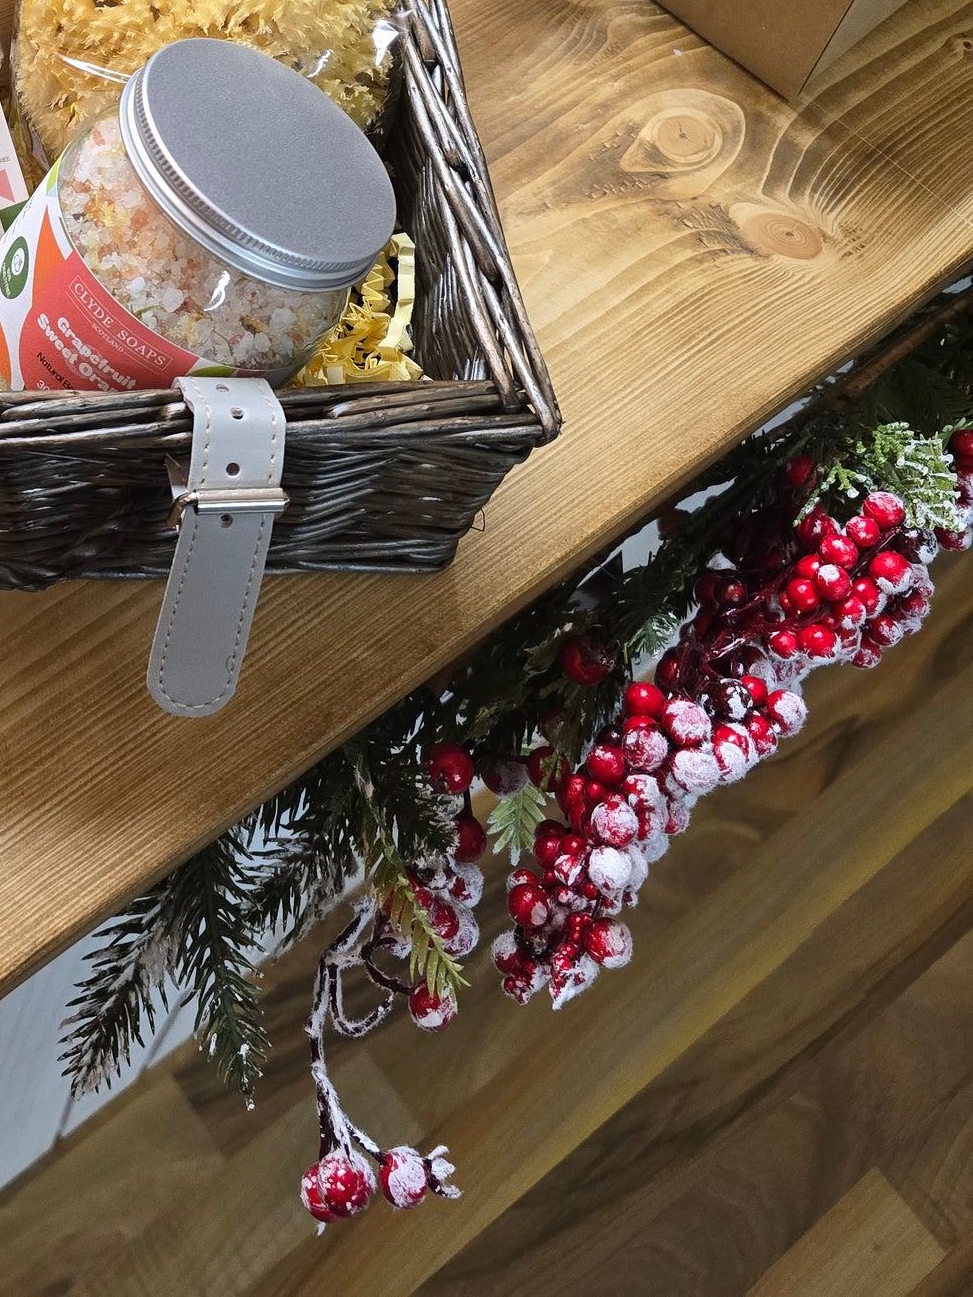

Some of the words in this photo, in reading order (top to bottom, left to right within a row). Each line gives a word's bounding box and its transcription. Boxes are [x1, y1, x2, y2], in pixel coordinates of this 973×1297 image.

[37, 313, 78, 364] Sweet
[74, 283, 114, 328] CLYDE
[117, 329, 166, 366] SOAPS
[91, 322, 124, 353] SCOTLAND
[37, 352, 64, 384] Natural
[57, 317, 137, 389] Grapefruit
